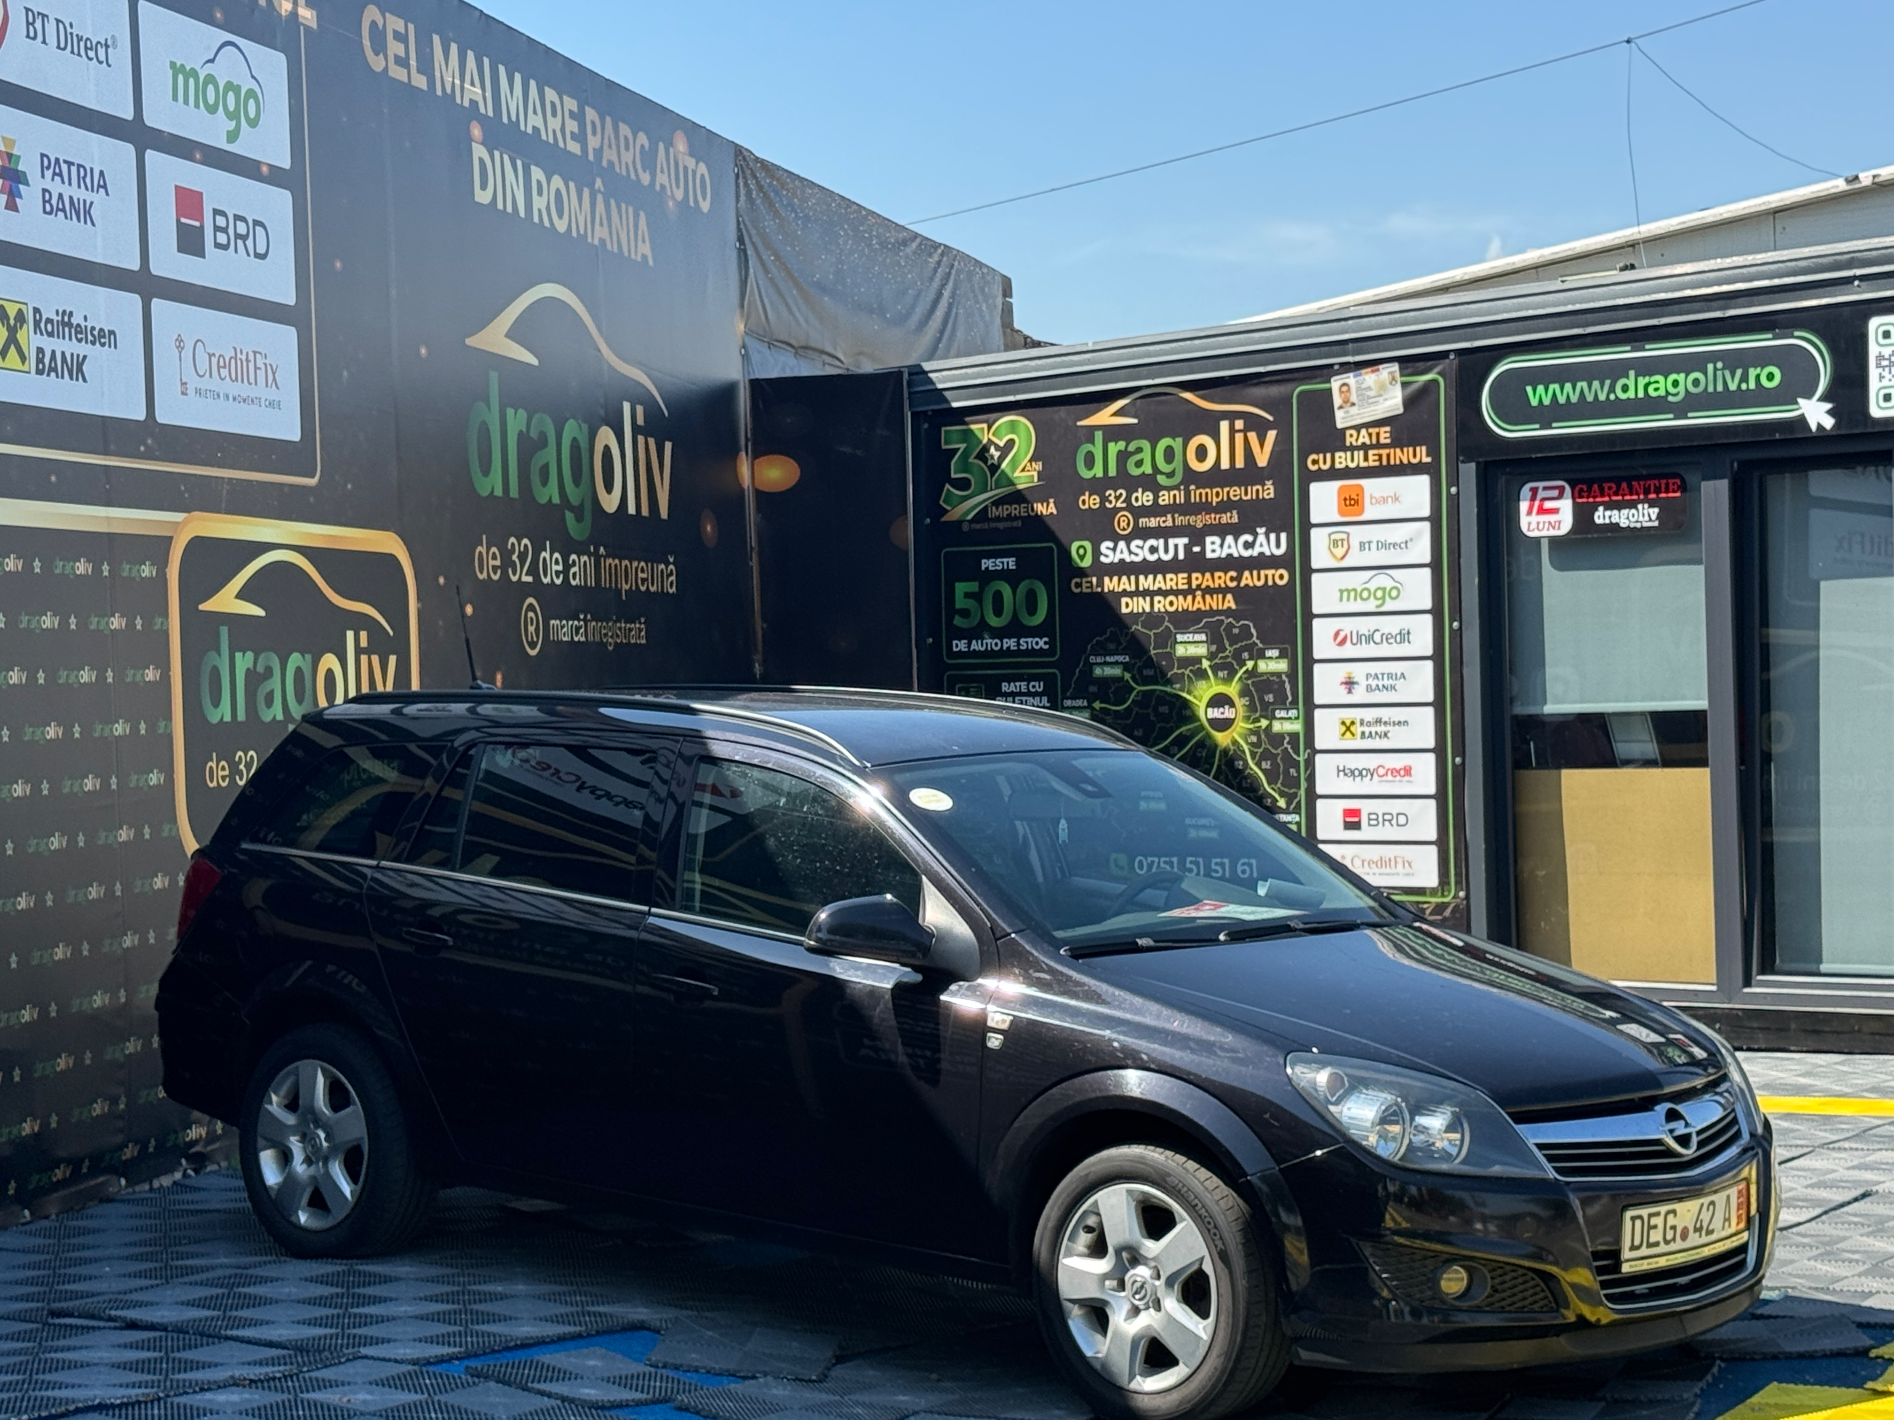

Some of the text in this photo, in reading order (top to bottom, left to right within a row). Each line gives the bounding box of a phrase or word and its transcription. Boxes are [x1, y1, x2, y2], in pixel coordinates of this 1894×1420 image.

[24, 6, 49, 45] BT
[169, 60, 262, 144] mogo
[361, 4, 711, 213] CEL MAI MARE PARC AUTO
[39, 152, 110, 197] PATRIA
[41, 187, 97, 228] BANK
[471, 141, 653, 266] DIN ROMÂNIA
[212, 207, 271, 260] BRD
[33, 306, 118, 350] Raiffeisen
[35, 346, 89, 384] BANK
[192, 338, 280, 391] CreditFix
[1525, 361, 1782, 407] www.dragoliv.ro
[1345, 426, 1391, 447] RATE
[466, 370, 672, 541] dragoliv
[939, 415, 1043, 511] 32 ANI
[1076, 419, 1278, 487] dragoliv
[1307, 446, 1432, 471] CU BULETINUL
[1078, 480, 1275, 510] de 32 de ani împreună
[1343, 492, 1402, 508] tbi bank
[1526, 485, 1566, 517] 12
[1573, 478, 1682, 503] GARANTIE
[988, 498, 1057, 519] ÎMPREUNĂ
[1139, 514, 1173, 529] marcă
[1175, 509, 1239, 530] înregistrată
[1594, 503, 1660, 527] dragoliv
[1527, 520, 1562, 532] LUNI
[1100, 537, 1189, 564] SASCUT
[1204, 527, 1288, 560] BACĂU
[1332, 538, 1346, 549] BT
[1359, 540, 1373, 552] BT
[475, 534, 677, 600] de 32 de ani împreună
[981, 557, 1017, 571] PESTE
[1070, 568, 1290, 594] CEL MAI MARE PARC AUTO
[953, 579, 1049, 629] 500
[1120, 594, 1236, 614] DIN ROMÂNIA
[1338, 585, 1402, 609] mogo
[549, 613, 585, 642] marcă
[586, 615, 647, 650] înregistrată
[952, 636, 1050, 651] DE AUTO PE STOC
[1350, 628, 1412, 647] UniCredit
[1001, 680, 1044, 693] RATE CU
[1365, 671, 1407, 682] PATRIA
[1365, 683, 1398, 693] BANK
[1359, 718, 1410, 729] Raiffeisen
[1359, 730, 1391, 740] BANK
[206, 750, 258, 788] de 32
[1336, 764, 1413, 782] HappyCredit
[1367, 812, 1409, 828] BRD
[1134, 855, 1258, 878] 0751 51 51 61
[1350, 854, 1414, 870] CreditFix
[1629, 1208, 1677, 1252] DEG
[1693, 1199, 1717, 1239] 42
[1721, 1194, 1732, 1231] A
